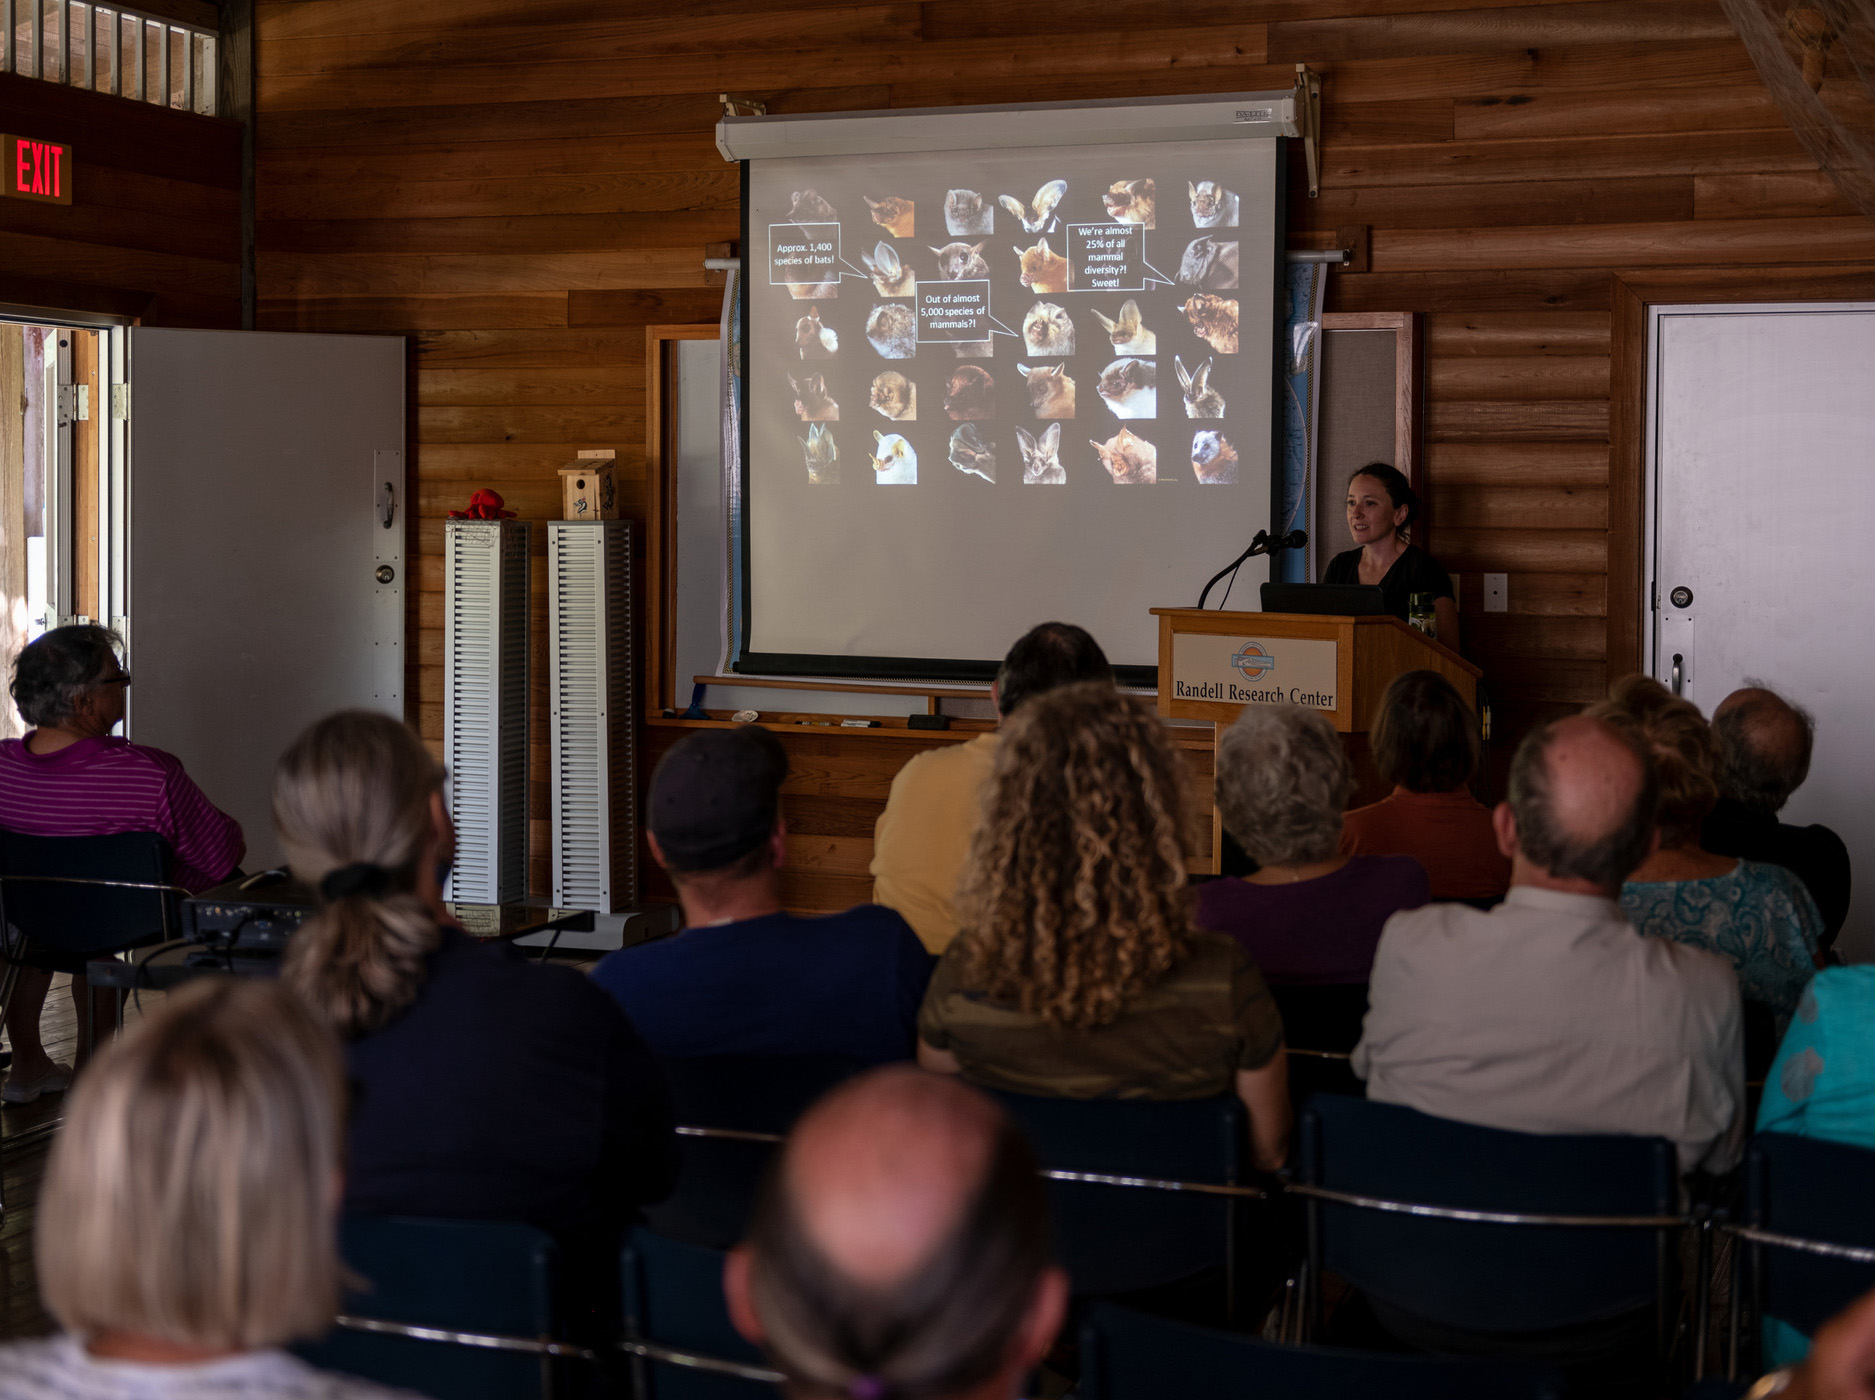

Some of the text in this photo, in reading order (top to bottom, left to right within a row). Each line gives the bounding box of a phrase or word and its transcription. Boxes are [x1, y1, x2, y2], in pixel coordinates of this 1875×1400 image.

[17, 139, 63, 197] EXIT
[1078, 226, 1133, 236] We're almost
[776, 242, 832, 254] Approx. 1,400
[1086, 239, 1126, 249] 25% of all
[774, 254, 834, 267] species of bats!
[1088, 252, 1123, 261] mammal
[1084, 265, 1127, 275] diversity?!
[1092, 278, 1119, 287] Sweet!
[925, 294, 980, 304] Out of almost
[921, 305, 986, 317] 5,000 species of
[929, 318, 976, 329] mammals?!
[1176, 680, 1334, 707] Randell Research Center
